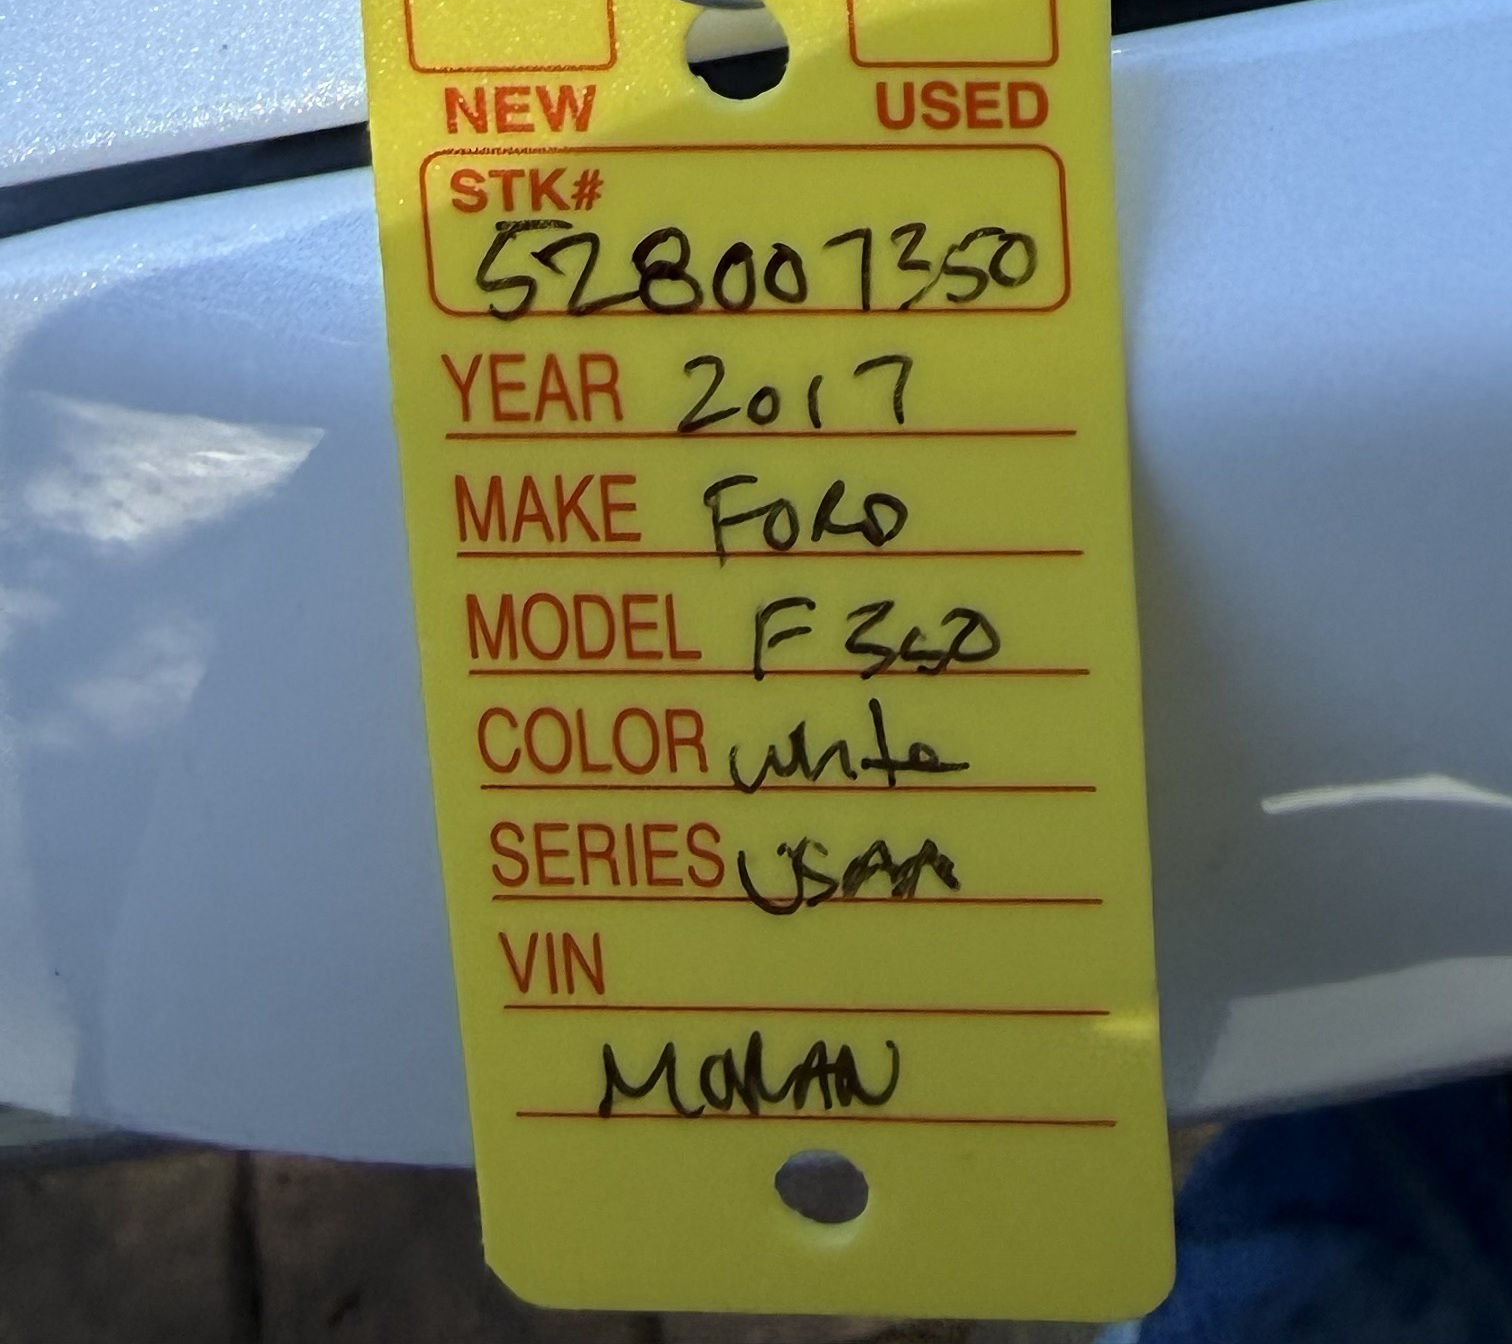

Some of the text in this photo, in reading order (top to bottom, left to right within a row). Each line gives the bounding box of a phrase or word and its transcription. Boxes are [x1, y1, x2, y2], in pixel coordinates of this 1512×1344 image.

[444, 84, 598, 134] NEW
[876, 81, 1049, 131] USED
[450, 169, 604, 216] STK#
[476, 219, 1038, 320] 528007350
[441, 353, 624, 425] YEAR
[678, 354, 913, 433] 2017
[455, 474, 642, 543] MAKE
[466, 593, 702, 661] MODEL
[476, 708, 709, 775] COLOR
[490, 822, 726, 888] SERIES
[499, 932, 605, 996] VIN
